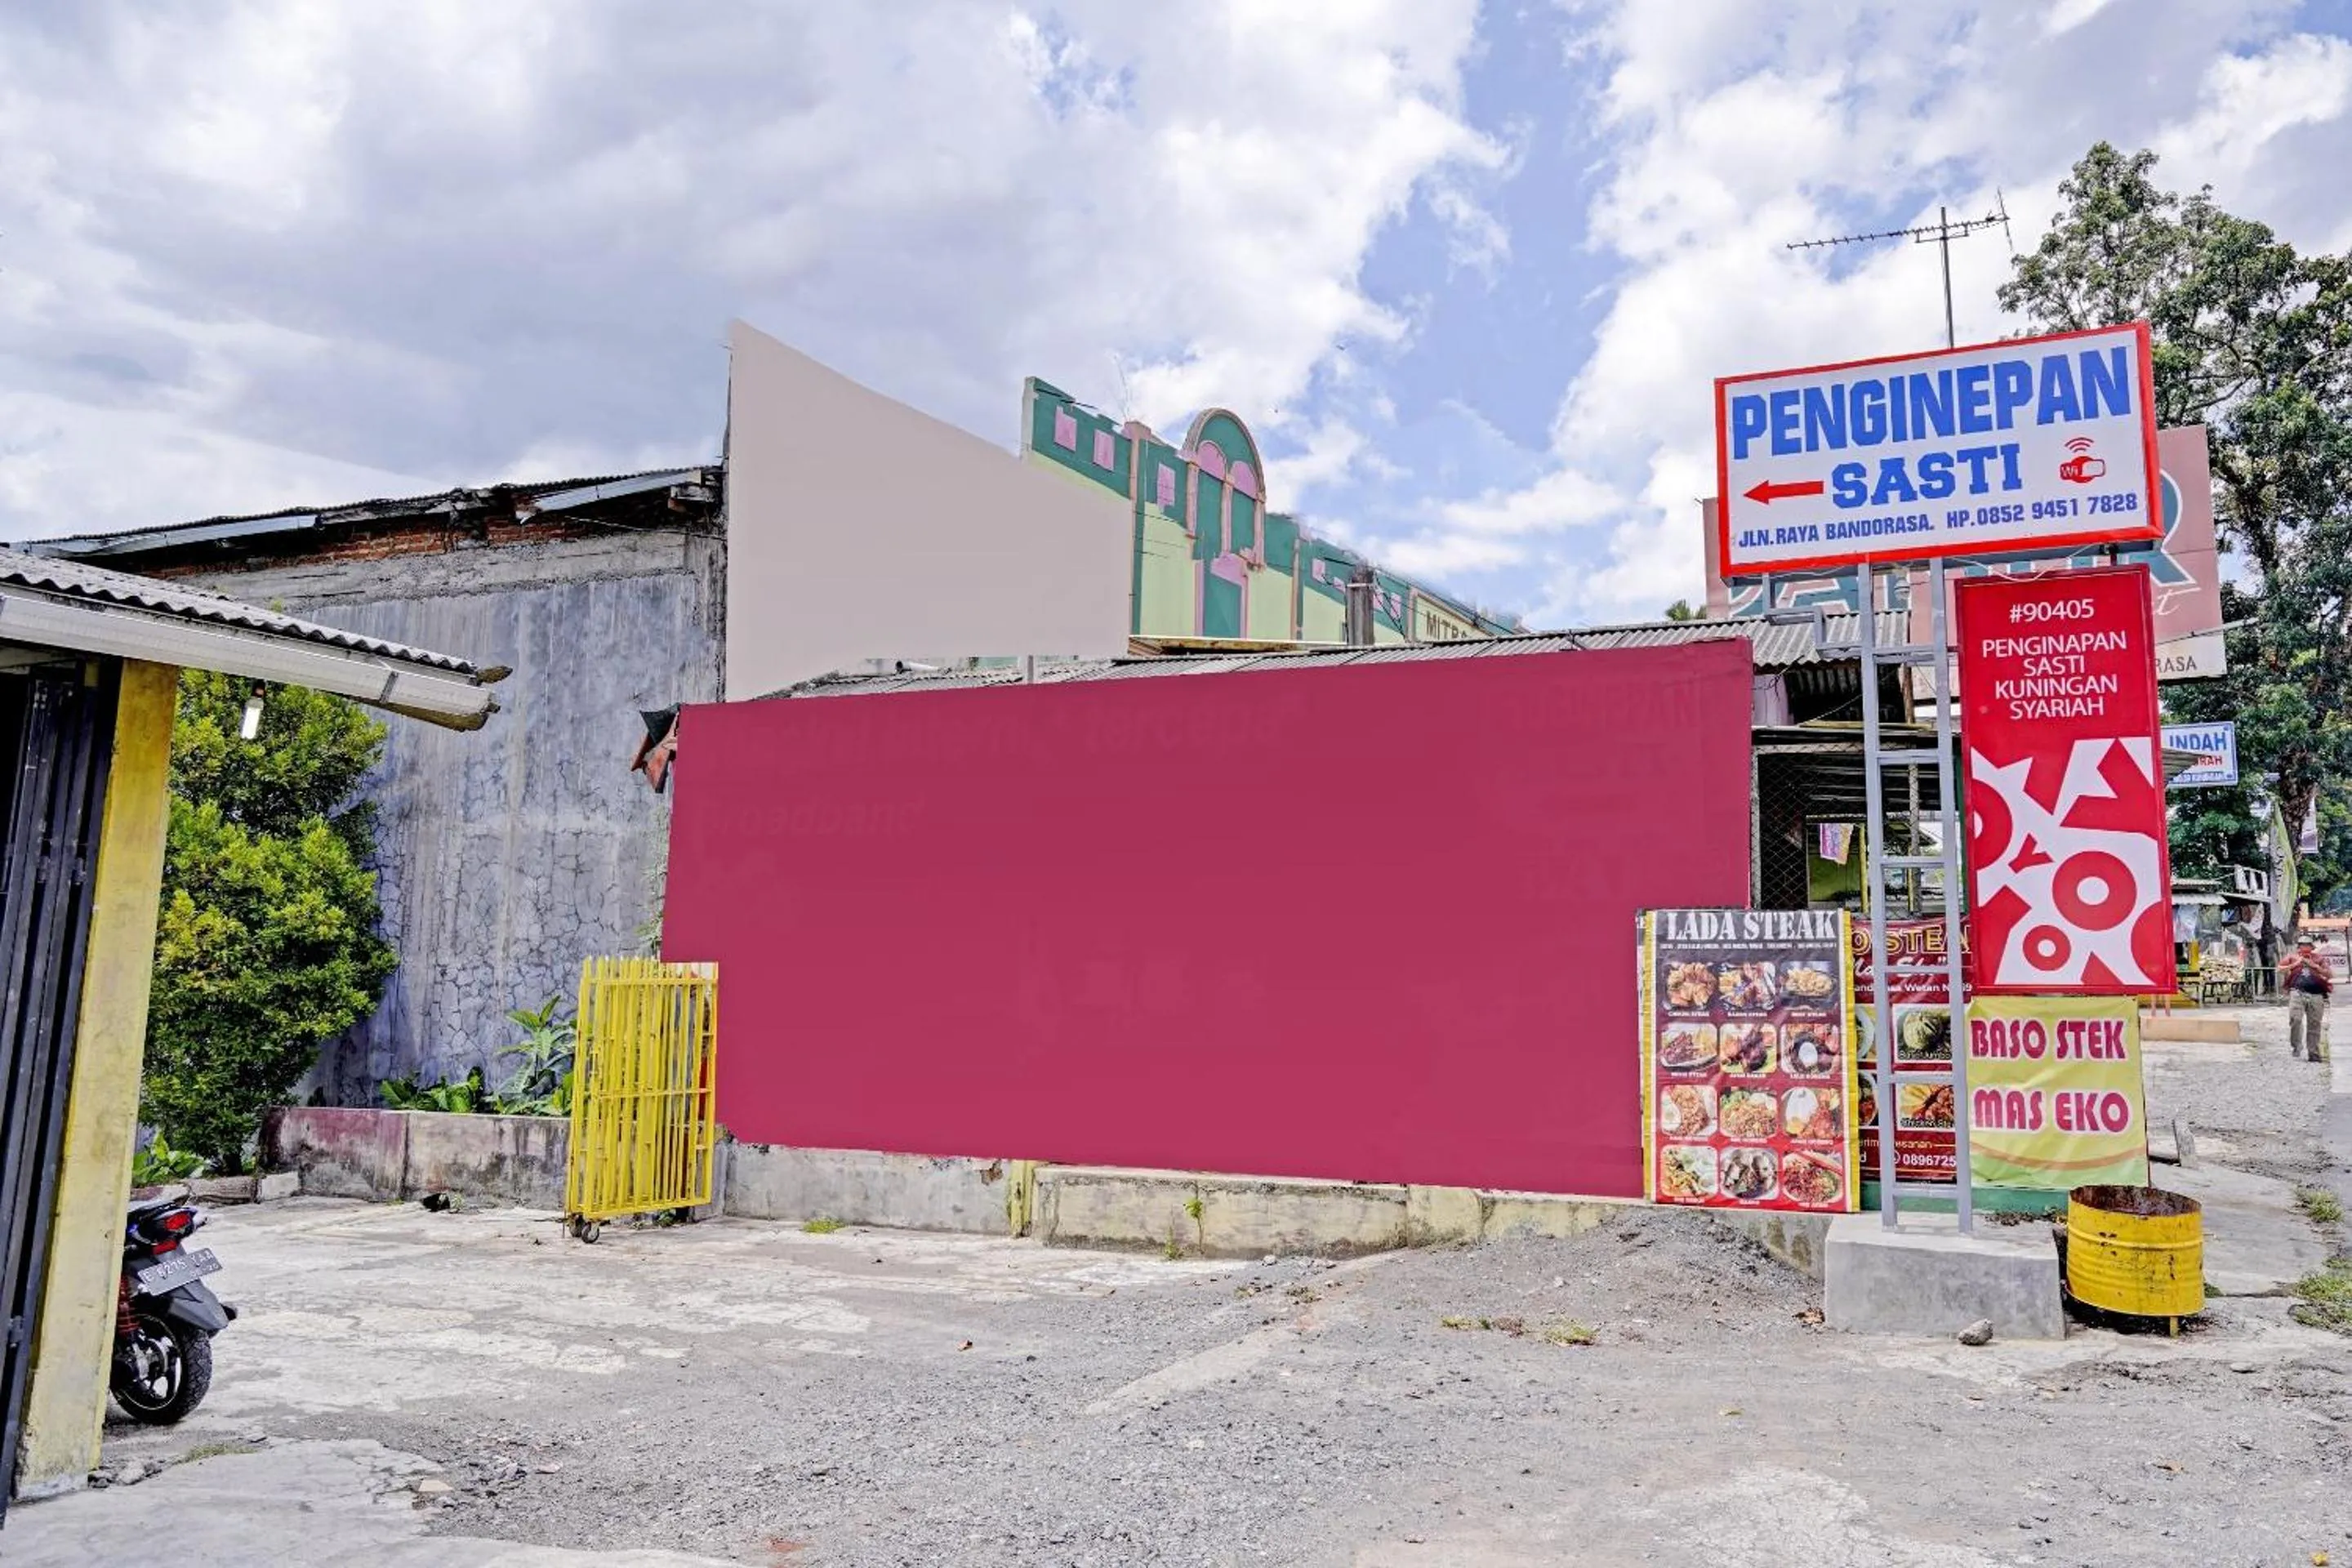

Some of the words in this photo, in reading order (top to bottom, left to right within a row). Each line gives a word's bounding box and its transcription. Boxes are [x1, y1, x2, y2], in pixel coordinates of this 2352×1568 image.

[1731, 346, 2132, 461] PENGINEPAN
[1831, 443, 2023, 510] SASTI
[2031, 498, 2079, 520] 9451
[2087, 493, 2139, 514] 7828
[2009, 598, 2095, 624] #90405
[1982, 630, 2127, 658] PENGINAPAN
[2023, 654, 2085, 677] SASTI
[1995, 674, 2118, 700] KUNINGAN
[2009, 696, 2105, 720] SYARIAH
[2168, 732, 2227, 752] INDAH
[1667, 911, 1737, 941] LADA
[1743, 910, 1837, 940] STEAK
[1970, 1020, 2047, 1059] BASO
[2056, 1020, 2127, 1060] STEK
[1973, 1089, 2043, 1130] MAS
[2055, 1092, 2130, 1134] EKO
